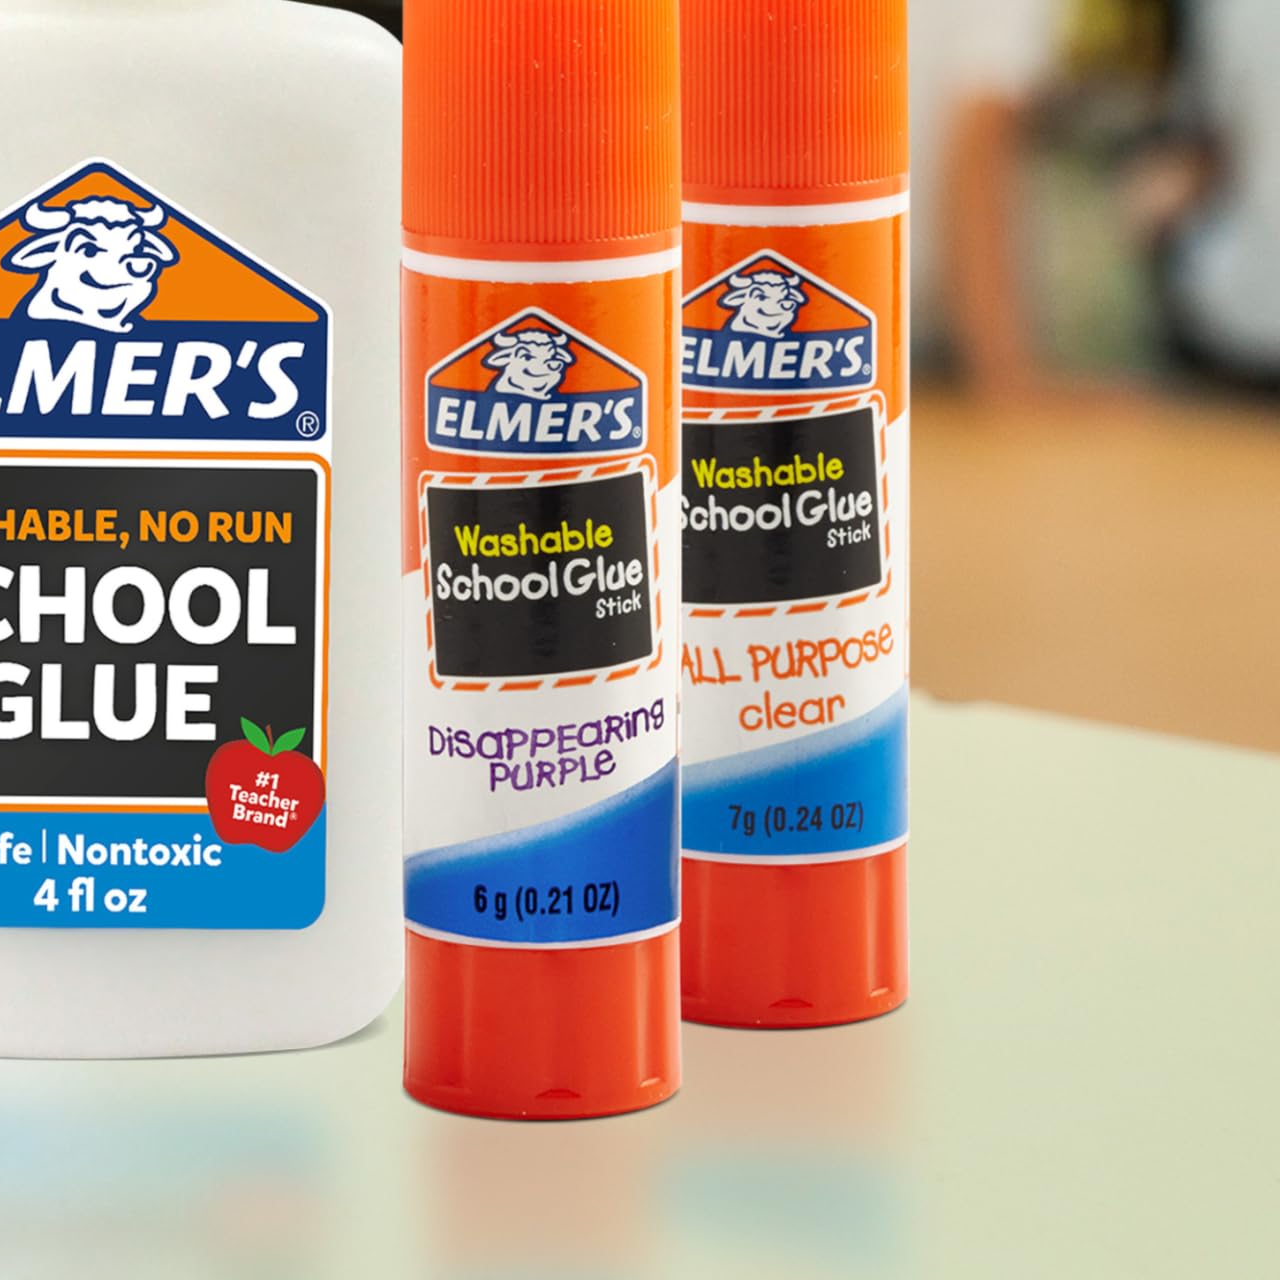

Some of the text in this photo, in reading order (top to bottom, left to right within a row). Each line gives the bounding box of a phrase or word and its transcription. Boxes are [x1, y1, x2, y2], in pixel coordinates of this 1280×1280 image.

[435, 396, 635, 443] ELMER'S
[691, 452, 844, 489] Washable
[796, 487, 873, 526] Glue
[139, 510, 199, 543] NO
[208, 511, 292, 544] RUN
[454, 518, 614, 557] Washable
[827, 521, 871, 548] Stick
[436, 555, 643, 602] School Glue
[595, 589, 642, 619] Stick
[739, 690, 846, 731] clear
[229, 784, 299, 811] Teacher
[255, 771, 279, 790] #1
[232, 803, 289, 828] Brand
[728, 804, 756, 837] 7g
[764, 803, 823, 839] (0.24
[58, 834, 222, 867] Nontoxic
[33, 876, 147, 913] 4 fl oz
[473, 881, 620, 922] 6 g (0.21 OZ)
